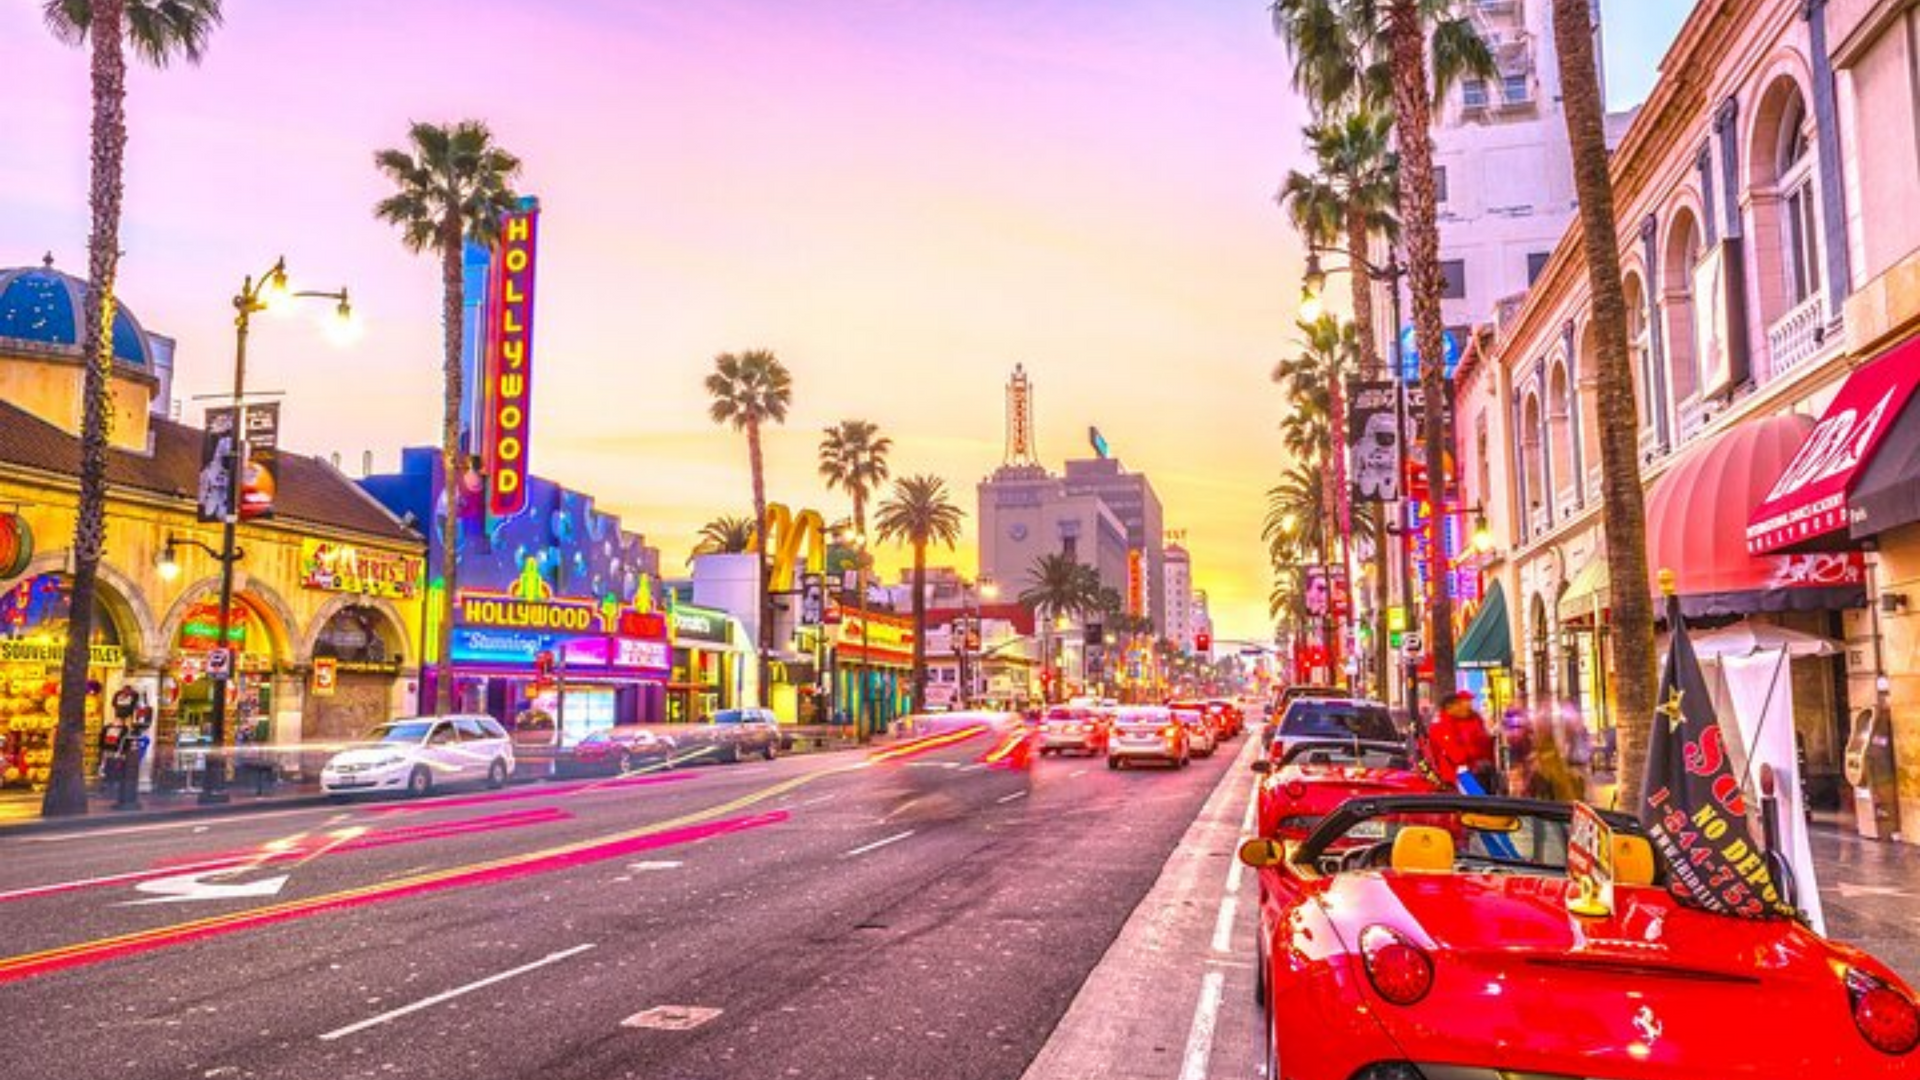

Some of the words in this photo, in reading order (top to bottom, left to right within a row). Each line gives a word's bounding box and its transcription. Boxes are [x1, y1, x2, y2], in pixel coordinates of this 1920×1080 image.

[498, 217, 529, 493] HOLLYWOOD
[464, 599, 591, 631] HOLLYWOOD
[2, 641, 63, 660] SOUVENI
[1691, 803, 1728, 840] NO
